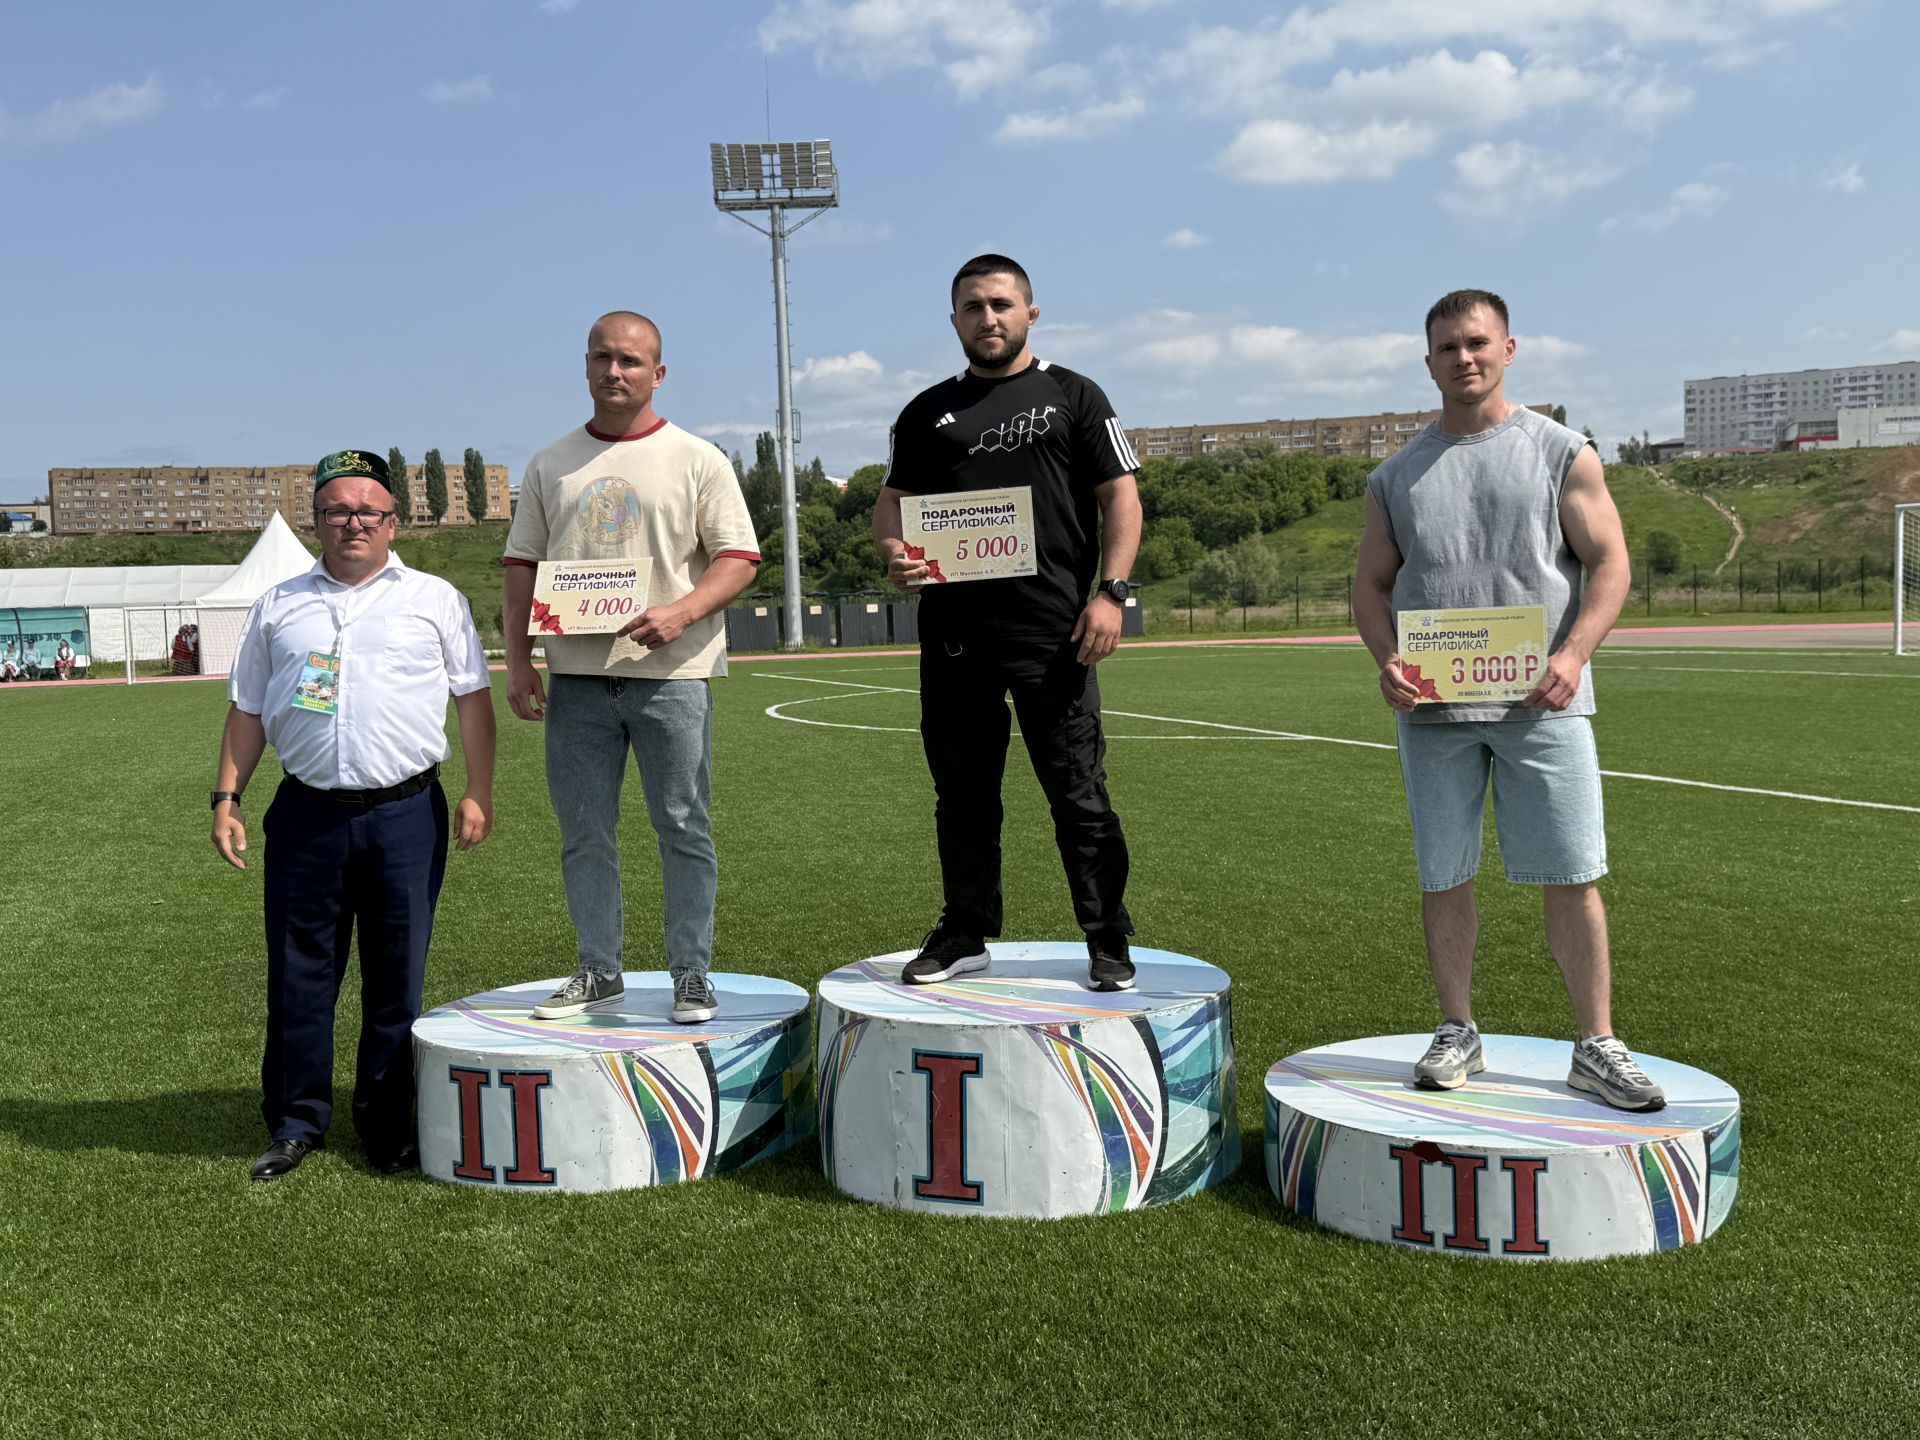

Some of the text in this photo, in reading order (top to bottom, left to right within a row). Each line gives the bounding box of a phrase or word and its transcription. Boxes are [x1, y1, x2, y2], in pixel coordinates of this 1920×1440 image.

[921, 502, 1015, 520] ПОДАРОЧНЫЙ
[921, 514, 1017, 532] СЕРТИФИКАТ
[956, 539, 968, 560] 5
[976, 535, 1018, 559] 000
[554, 569, 637, 582] ПОДАРОЧНЫЙ
[552, 579, 637, 592] СЕРТИФИКАТ
[577, 599, 590, 616] 4
[594, 597, 633, 616] 000
[1408, 628, 1488, 641] ПОДАРОЧНЫЙ
[1408, 640, 1490, 652] СЕРТИФИКАТ
[1451, 657, 1465, 684] 3
[1472, 655, 1517, 683] 000
[448, 1063, 558, 1187] II
[912, 1047, 984, 1206] I
[1389, 1143, 1550, 1257] III
